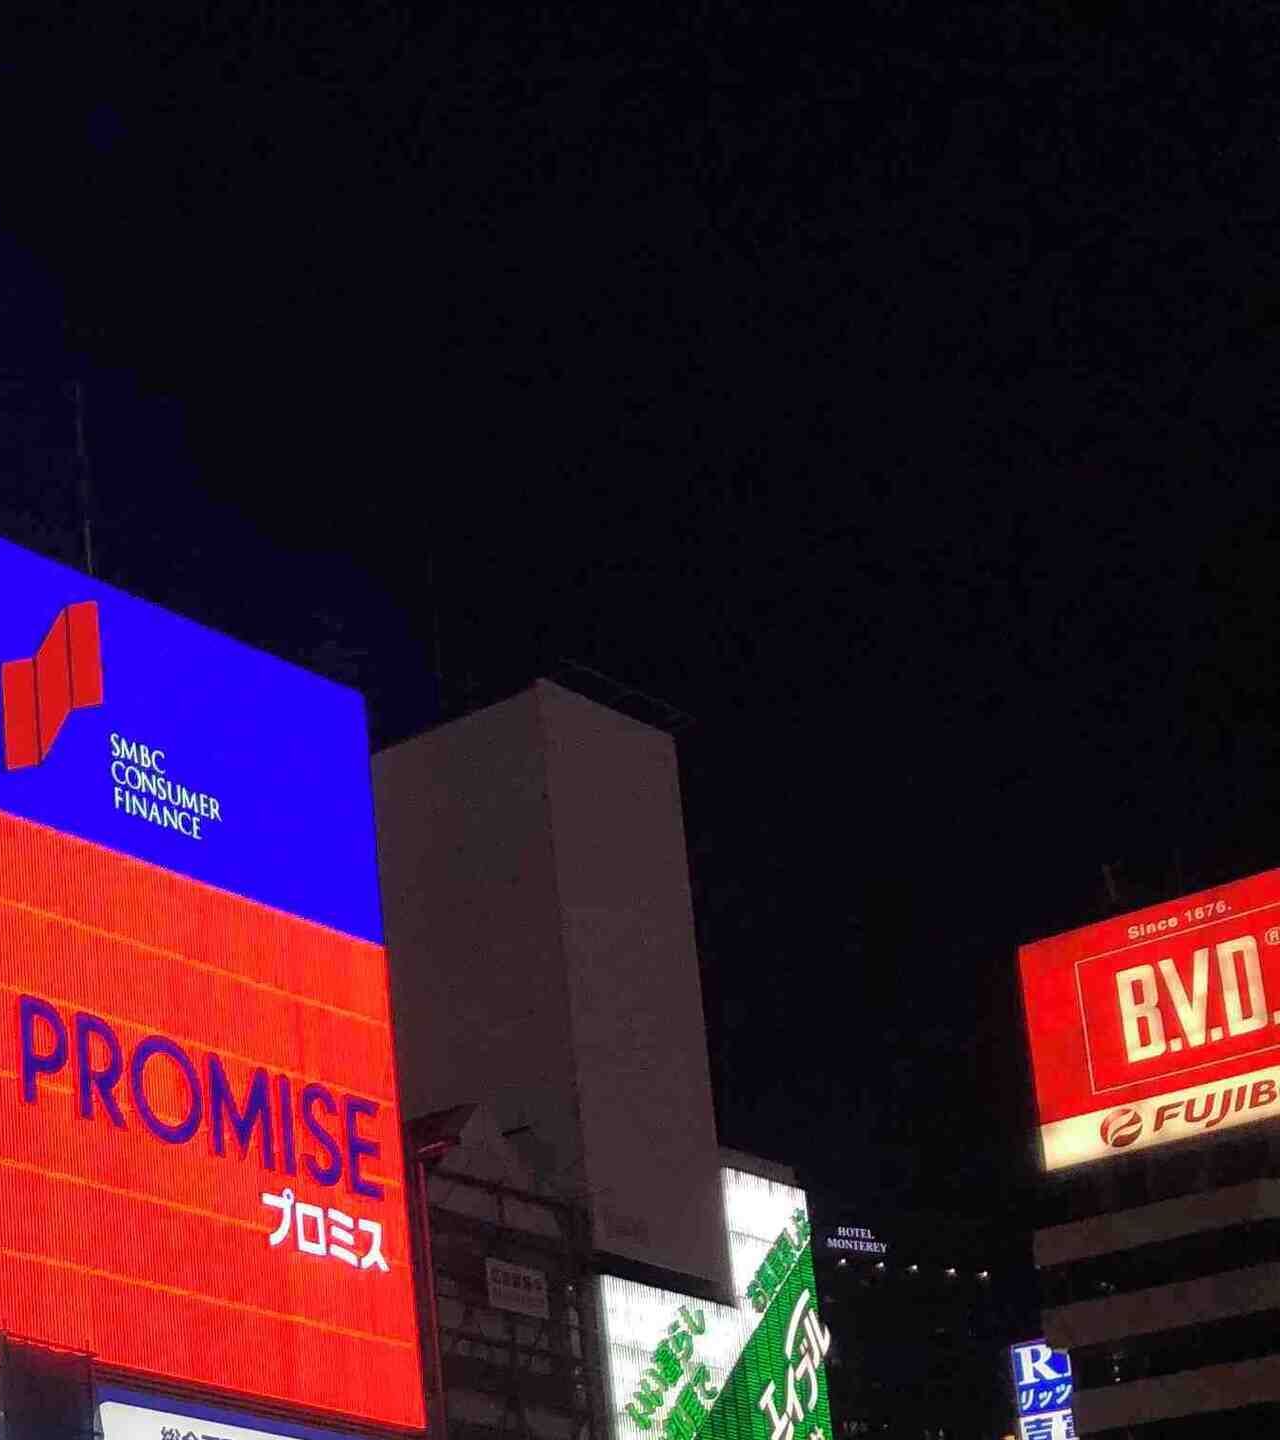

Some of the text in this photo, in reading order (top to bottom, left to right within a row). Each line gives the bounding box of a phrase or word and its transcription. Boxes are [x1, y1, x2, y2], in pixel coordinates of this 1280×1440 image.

[110, 732, 165, 778] SMBC
[110, 762, 222, 822] CONSUMER
[114, 787, 203, 840] FINANCE
[19, 994, 385, 1200] PROMISE
[262, 1188, 389, 1272] プロミス
[827, 1237, 889, 1254] MONTEREY
[838, 1227, 875, 1240] HOTEL
